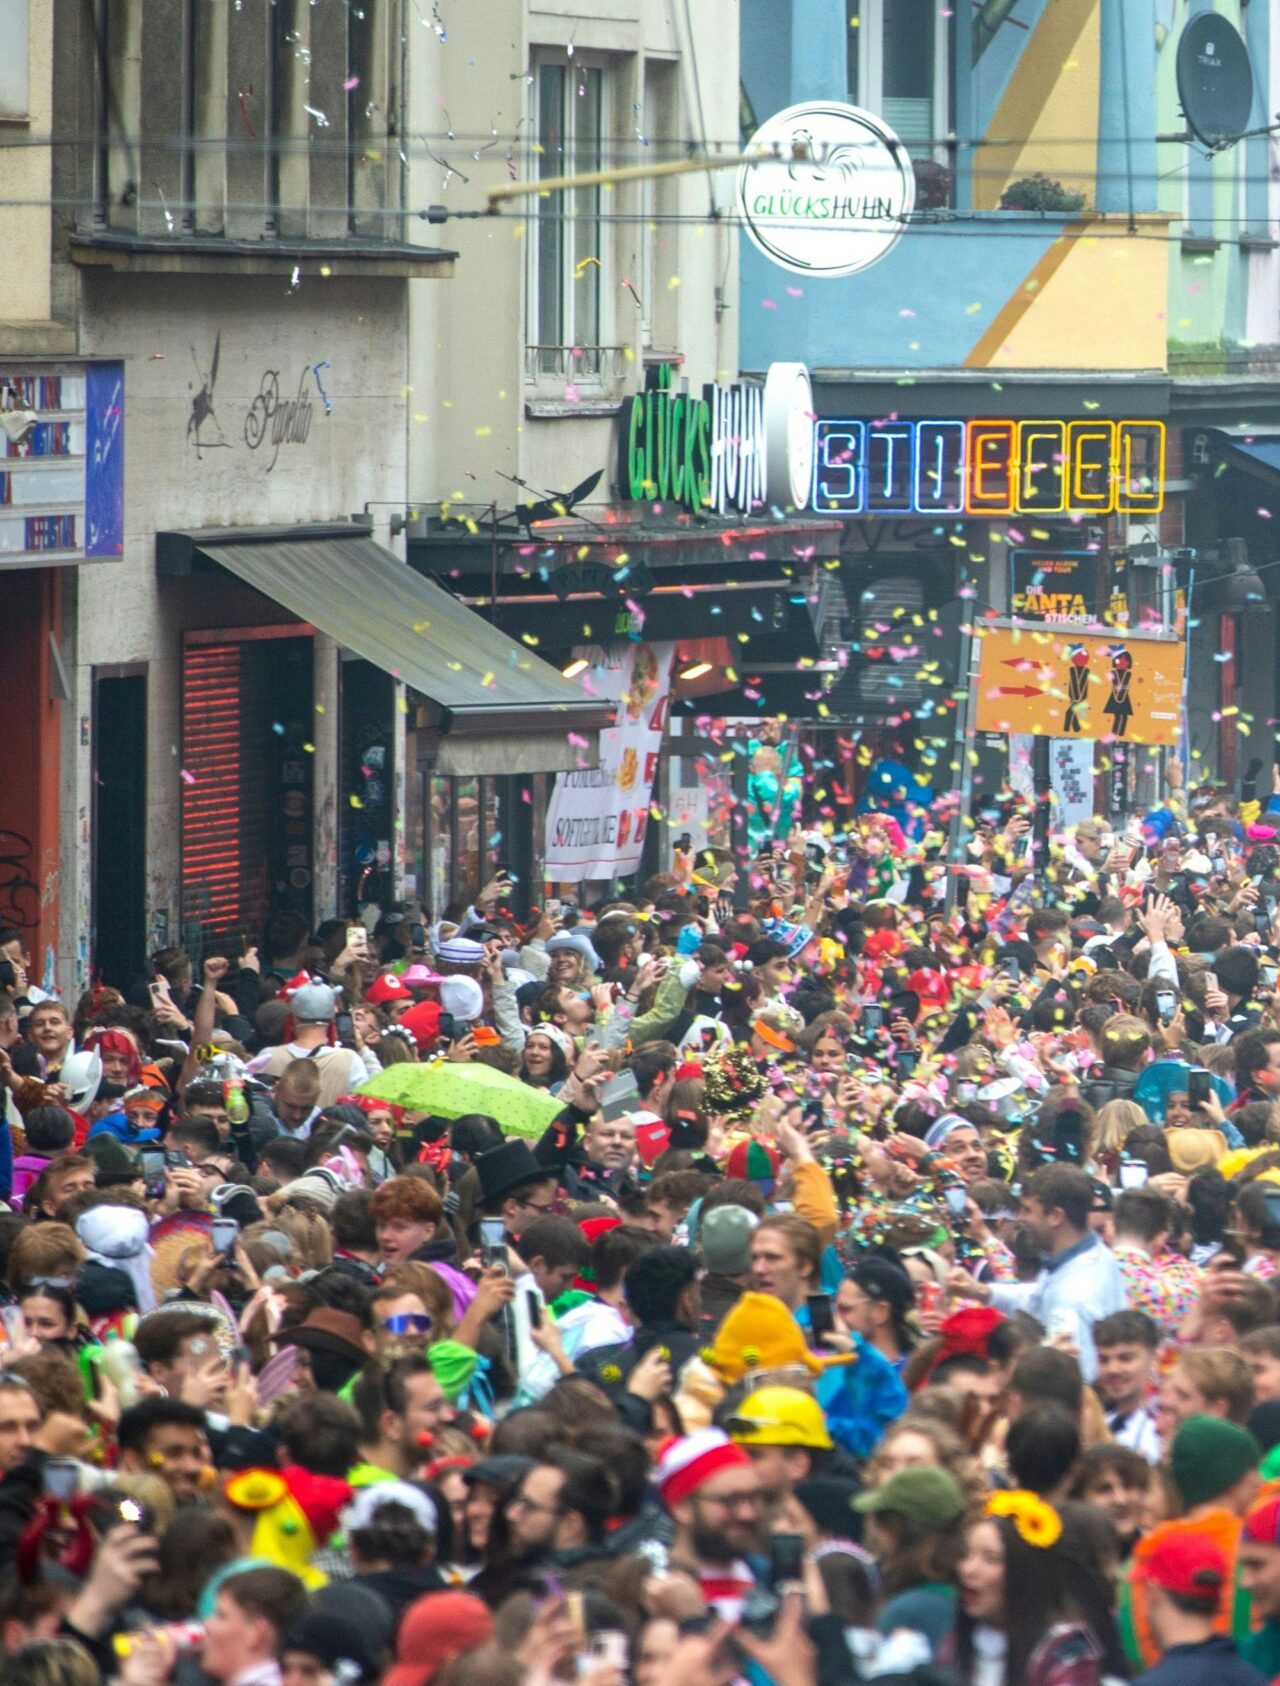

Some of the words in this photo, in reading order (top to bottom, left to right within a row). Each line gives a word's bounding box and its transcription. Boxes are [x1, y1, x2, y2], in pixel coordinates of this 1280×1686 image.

[753, 189, 892, 219] GLÜCKSHUHN
[629, 362, 768, 515] GLÜCKSHUHN
[820, 433, 1155, 499] STIEFEL
[1026, 585, 1044, 596] DIE
[1012, 593, 1087, 616] FANTA
[1045, 613, 1097, 625] STISCHEN
